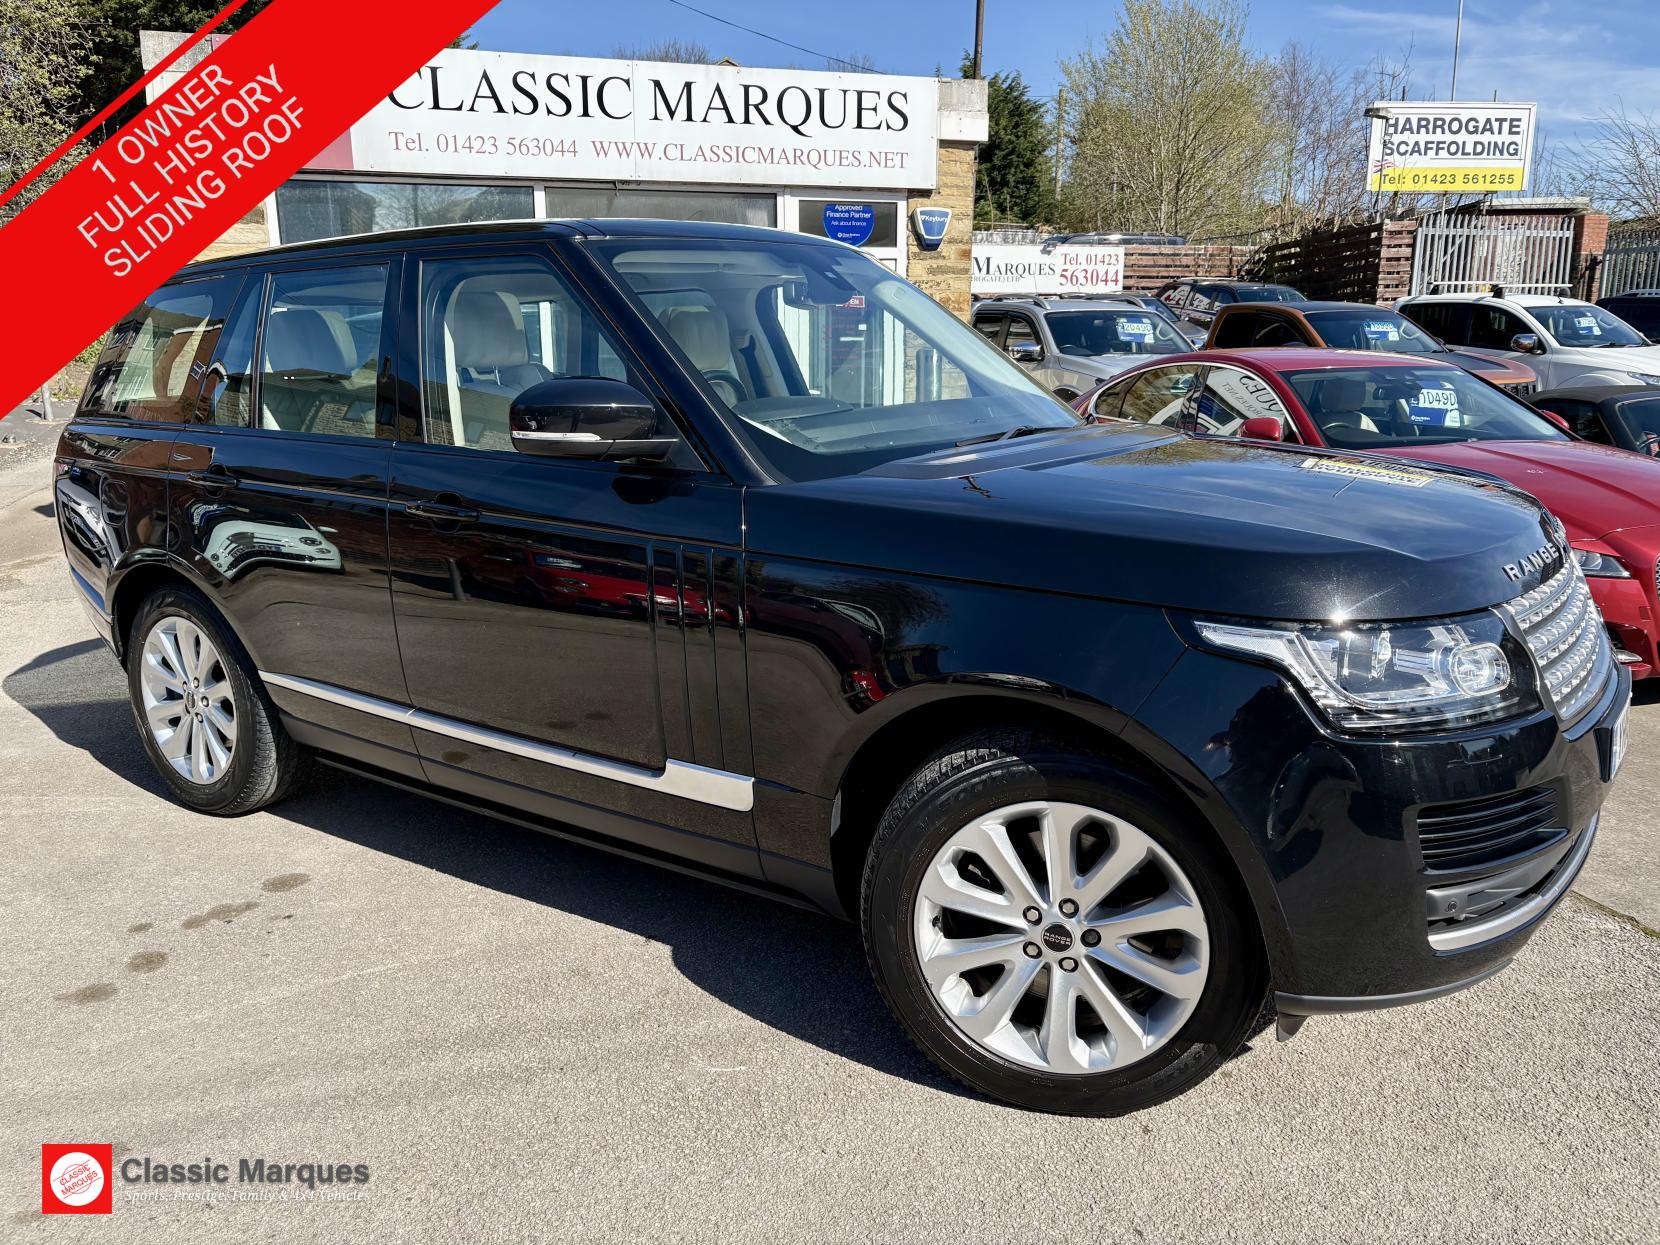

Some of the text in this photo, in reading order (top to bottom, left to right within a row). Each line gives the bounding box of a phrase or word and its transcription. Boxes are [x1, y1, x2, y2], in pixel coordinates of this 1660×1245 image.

[388, 66, 909, 138] CLASSIC MARQUES
[1387, 117, 1523, 135] HARROGATE
[388, 131, 909, 170] Tel. 01423 563044 WWW.CLASSICMARQUES.NET
[1384, 140, 1519, 157] SCAFFOLDING
[1382, 173, 1515, 185] Tel: 01423 561255
[972, 257, 1056, 278] MARQUES
[1061, 253, 1119, 266] Tel. 01423
[1059, 269, 1119, 287] 563044
[1502, 542, 1559, 582] RANGE
[1043, 935, 1071, 946] ROVER
[1044, 932, 1071, 943] RANGE
